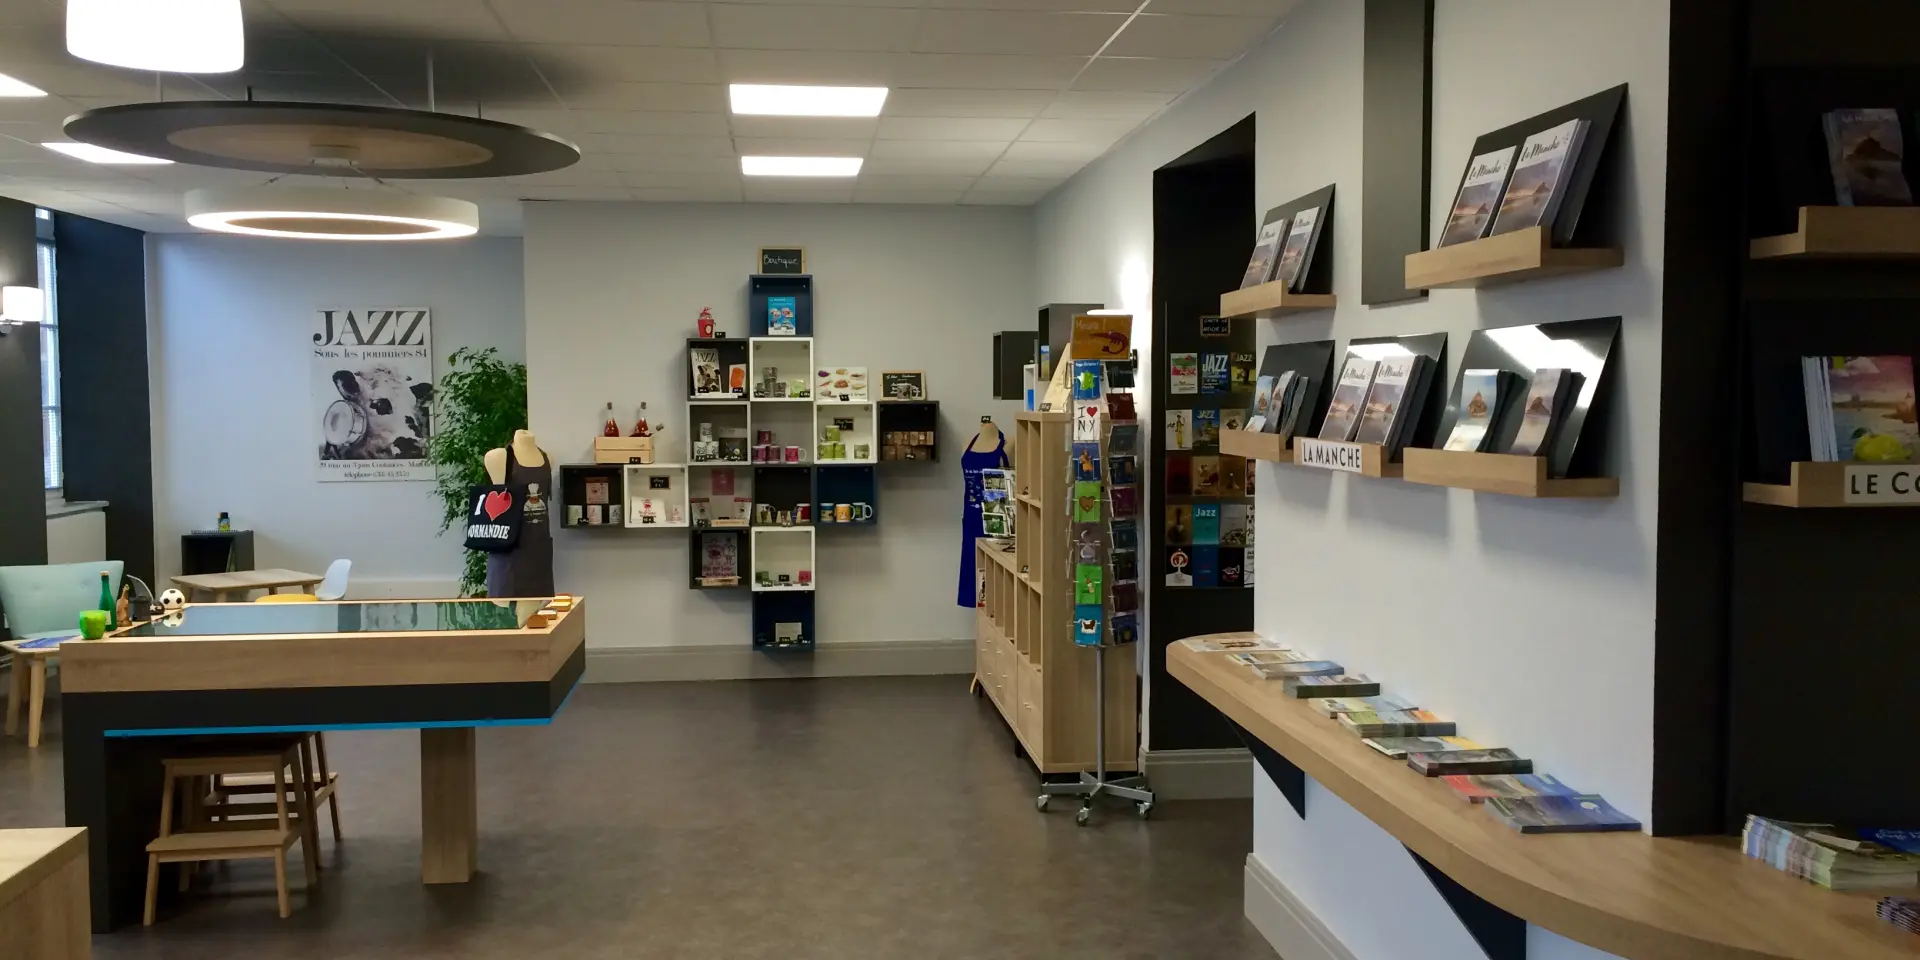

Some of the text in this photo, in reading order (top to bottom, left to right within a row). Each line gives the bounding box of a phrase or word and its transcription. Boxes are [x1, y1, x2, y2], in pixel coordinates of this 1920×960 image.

[763, 254, 799, 269] Boutique
[312, 309, 427, 347] JAZZ
[314, 348, 340, 358] Sous
[344, 348, 359, 358] les
[362, 348, 413, 360] pommiers
[1202, 353, 1229, 374] JAZZ
[1078, 406, 1086, 419] I
[1303, 442, 1361, 469] LA MANCHE
[1851, 474, 1878, 495] LE
[474, 493, 486, 516] I
[1195, 508, 1217, 517] Jazz
